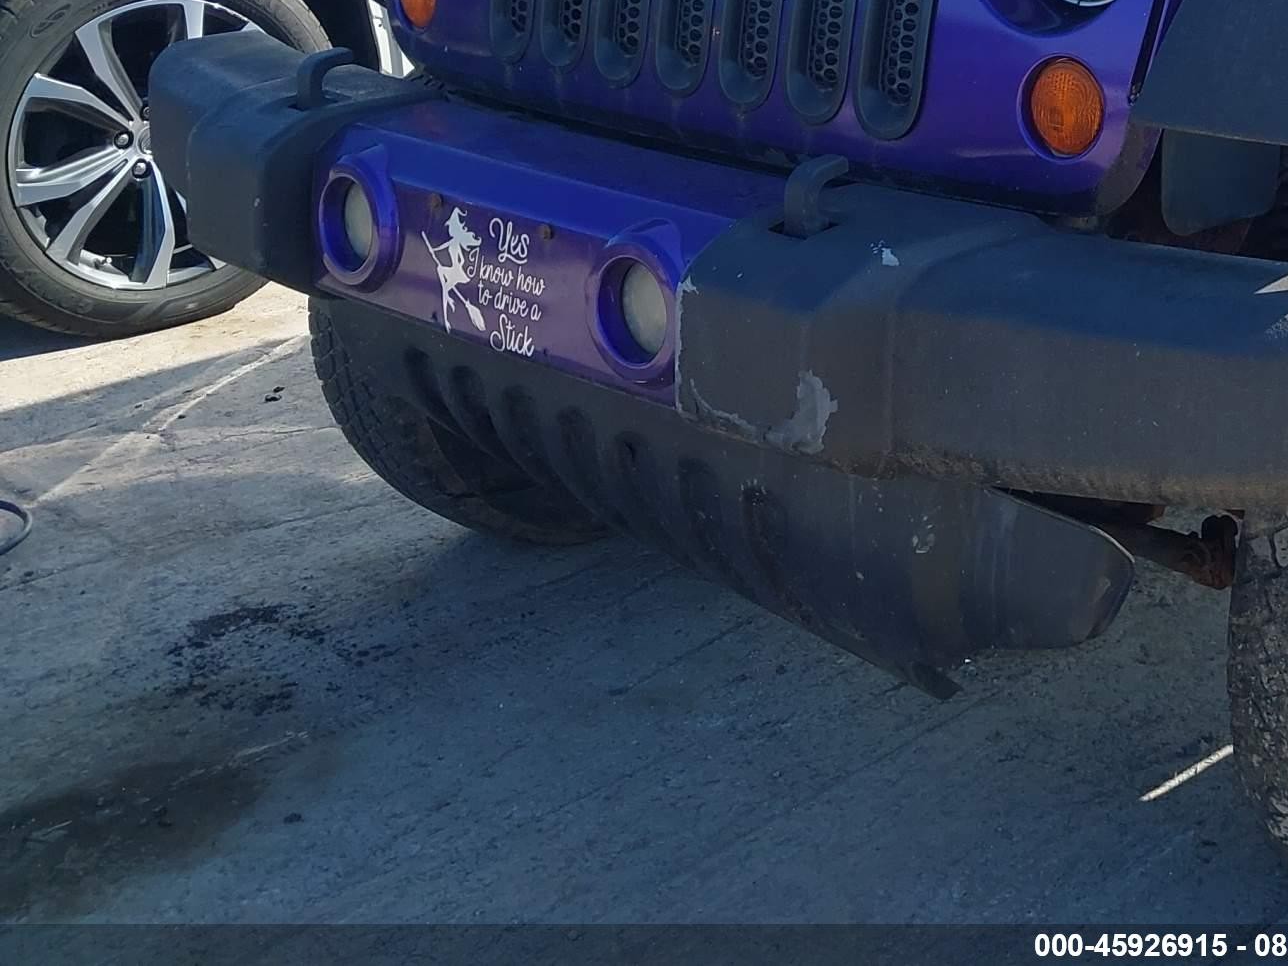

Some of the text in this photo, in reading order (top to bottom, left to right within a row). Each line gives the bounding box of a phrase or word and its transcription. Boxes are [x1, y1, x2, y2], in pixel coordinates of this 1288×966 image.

[489, 218, 530, 265] Yes
[480, 256, 513, 287] know
[516, 266, 546, 296] how
[478, 281, 541, 322] to drive a
[490, 314, 535, 357] Stick
